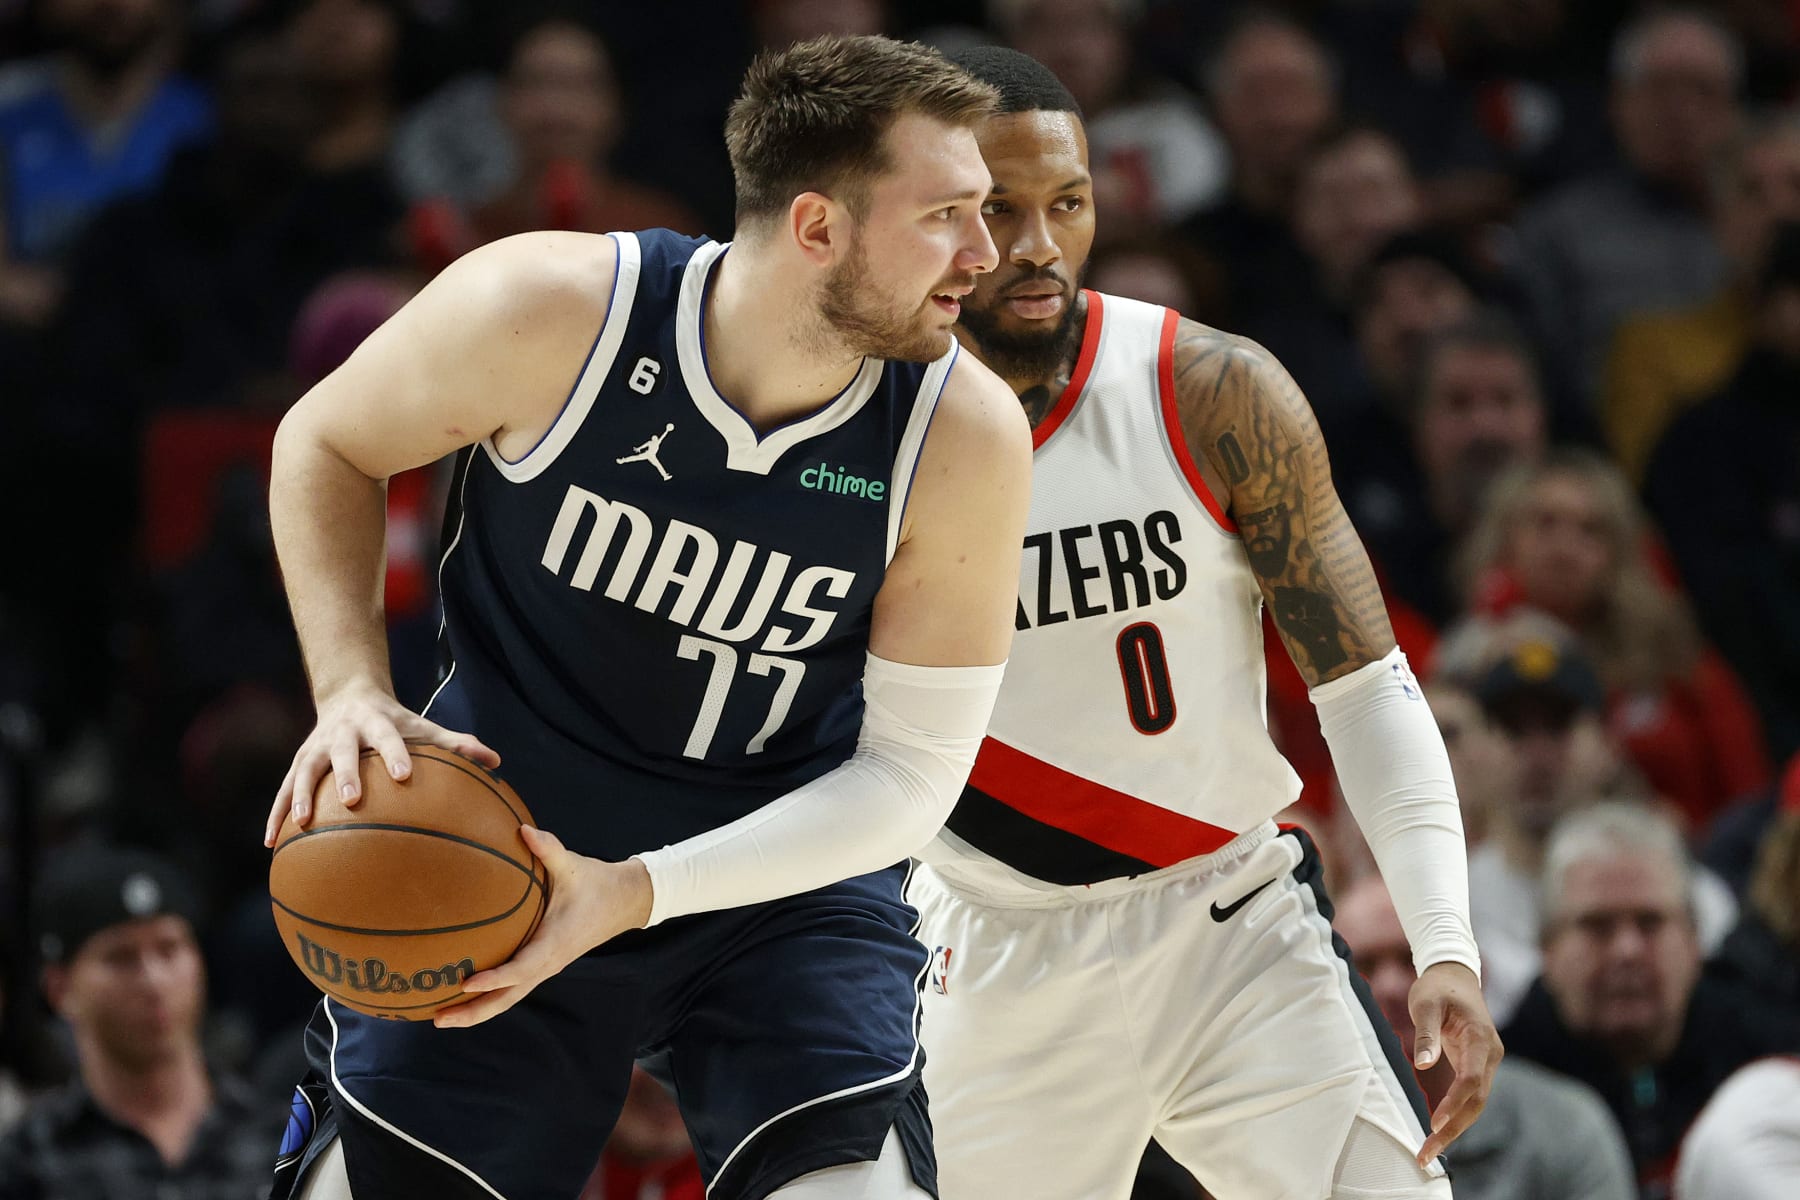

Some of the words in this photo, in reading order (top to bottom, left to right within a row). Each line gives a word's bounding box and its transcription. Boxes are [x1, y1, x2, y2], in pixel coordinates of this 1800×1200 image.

[628, 356, 661, 396] 6
[800, 462, 886, 501] chime
[541, 483, 857, 653] MAVS
[675, 633, 807, 760] 77
[1116, 621, 1177, 736] 0
[296, 930, 476, 994] Wilson
